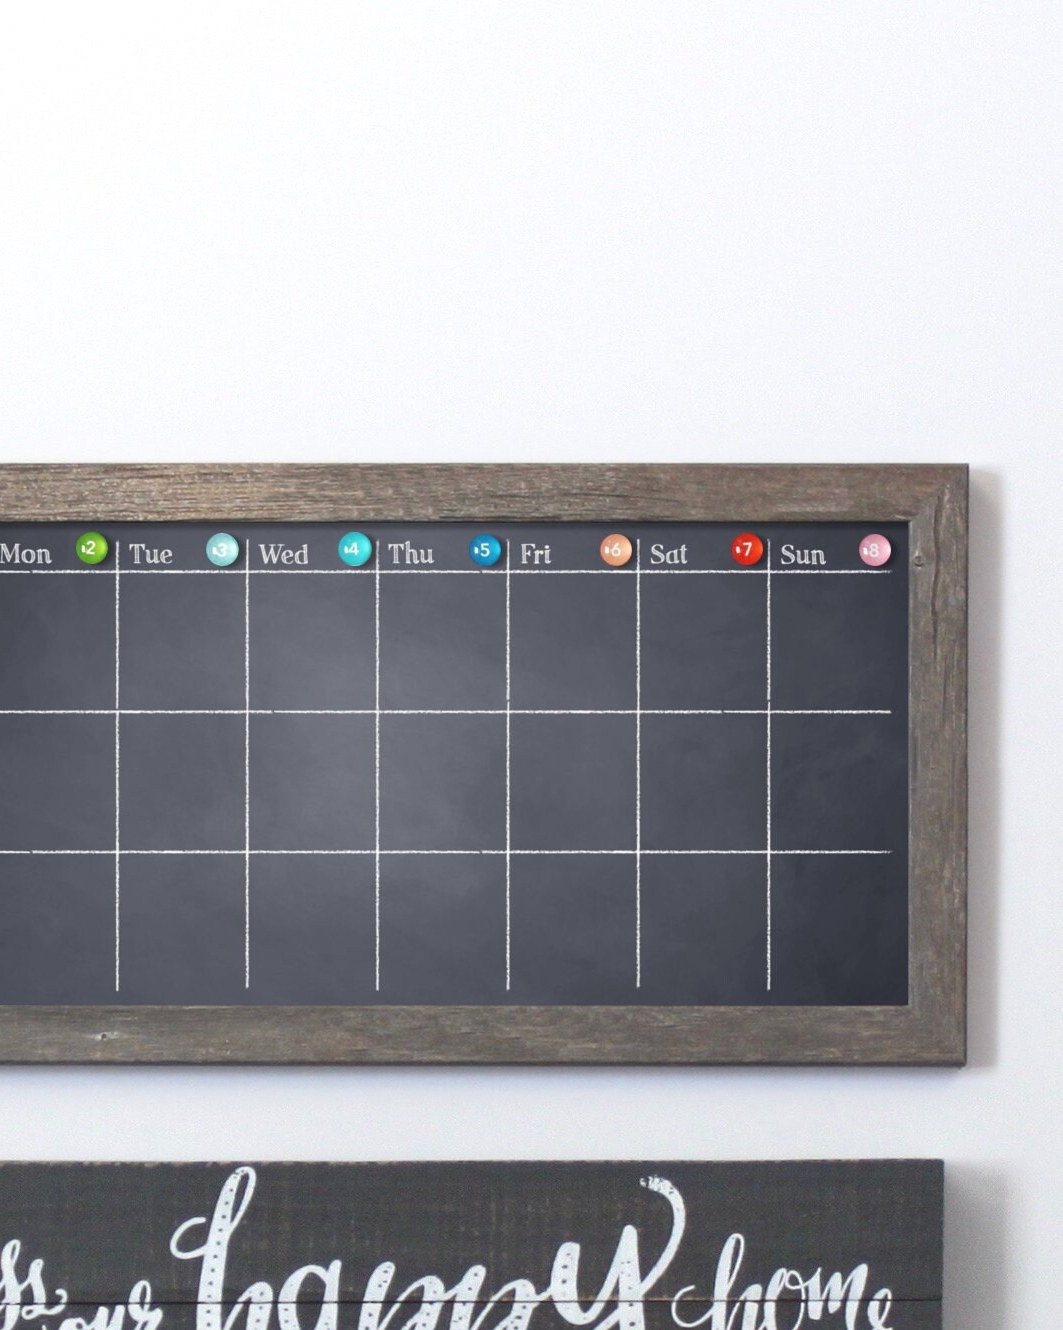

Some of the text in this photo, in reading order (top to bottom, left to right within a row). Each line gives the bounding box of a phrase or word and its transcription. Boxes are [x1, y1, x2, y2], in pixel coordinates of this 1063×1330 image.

[0, 543, 52, 565] Mon
[85, 541, 96, 555] 2
[129, 543, 173, 565] Tue
[216, 543, 227, 557] 3
[258, 543, 309, 565] Wed
[348, 541, 360, 556] 4
[388, 542, 435, 565] Thu
[479, 543, 491, 557] 5
[520, 543, 552, 565] Fri
[610, 542, 622, 557] 6
[650, 543, 688, 565] Sat
[742, 541, 753, 556] 7
[780, 544, 827, 565] Sun
[869, 543, 880, 558] 8
